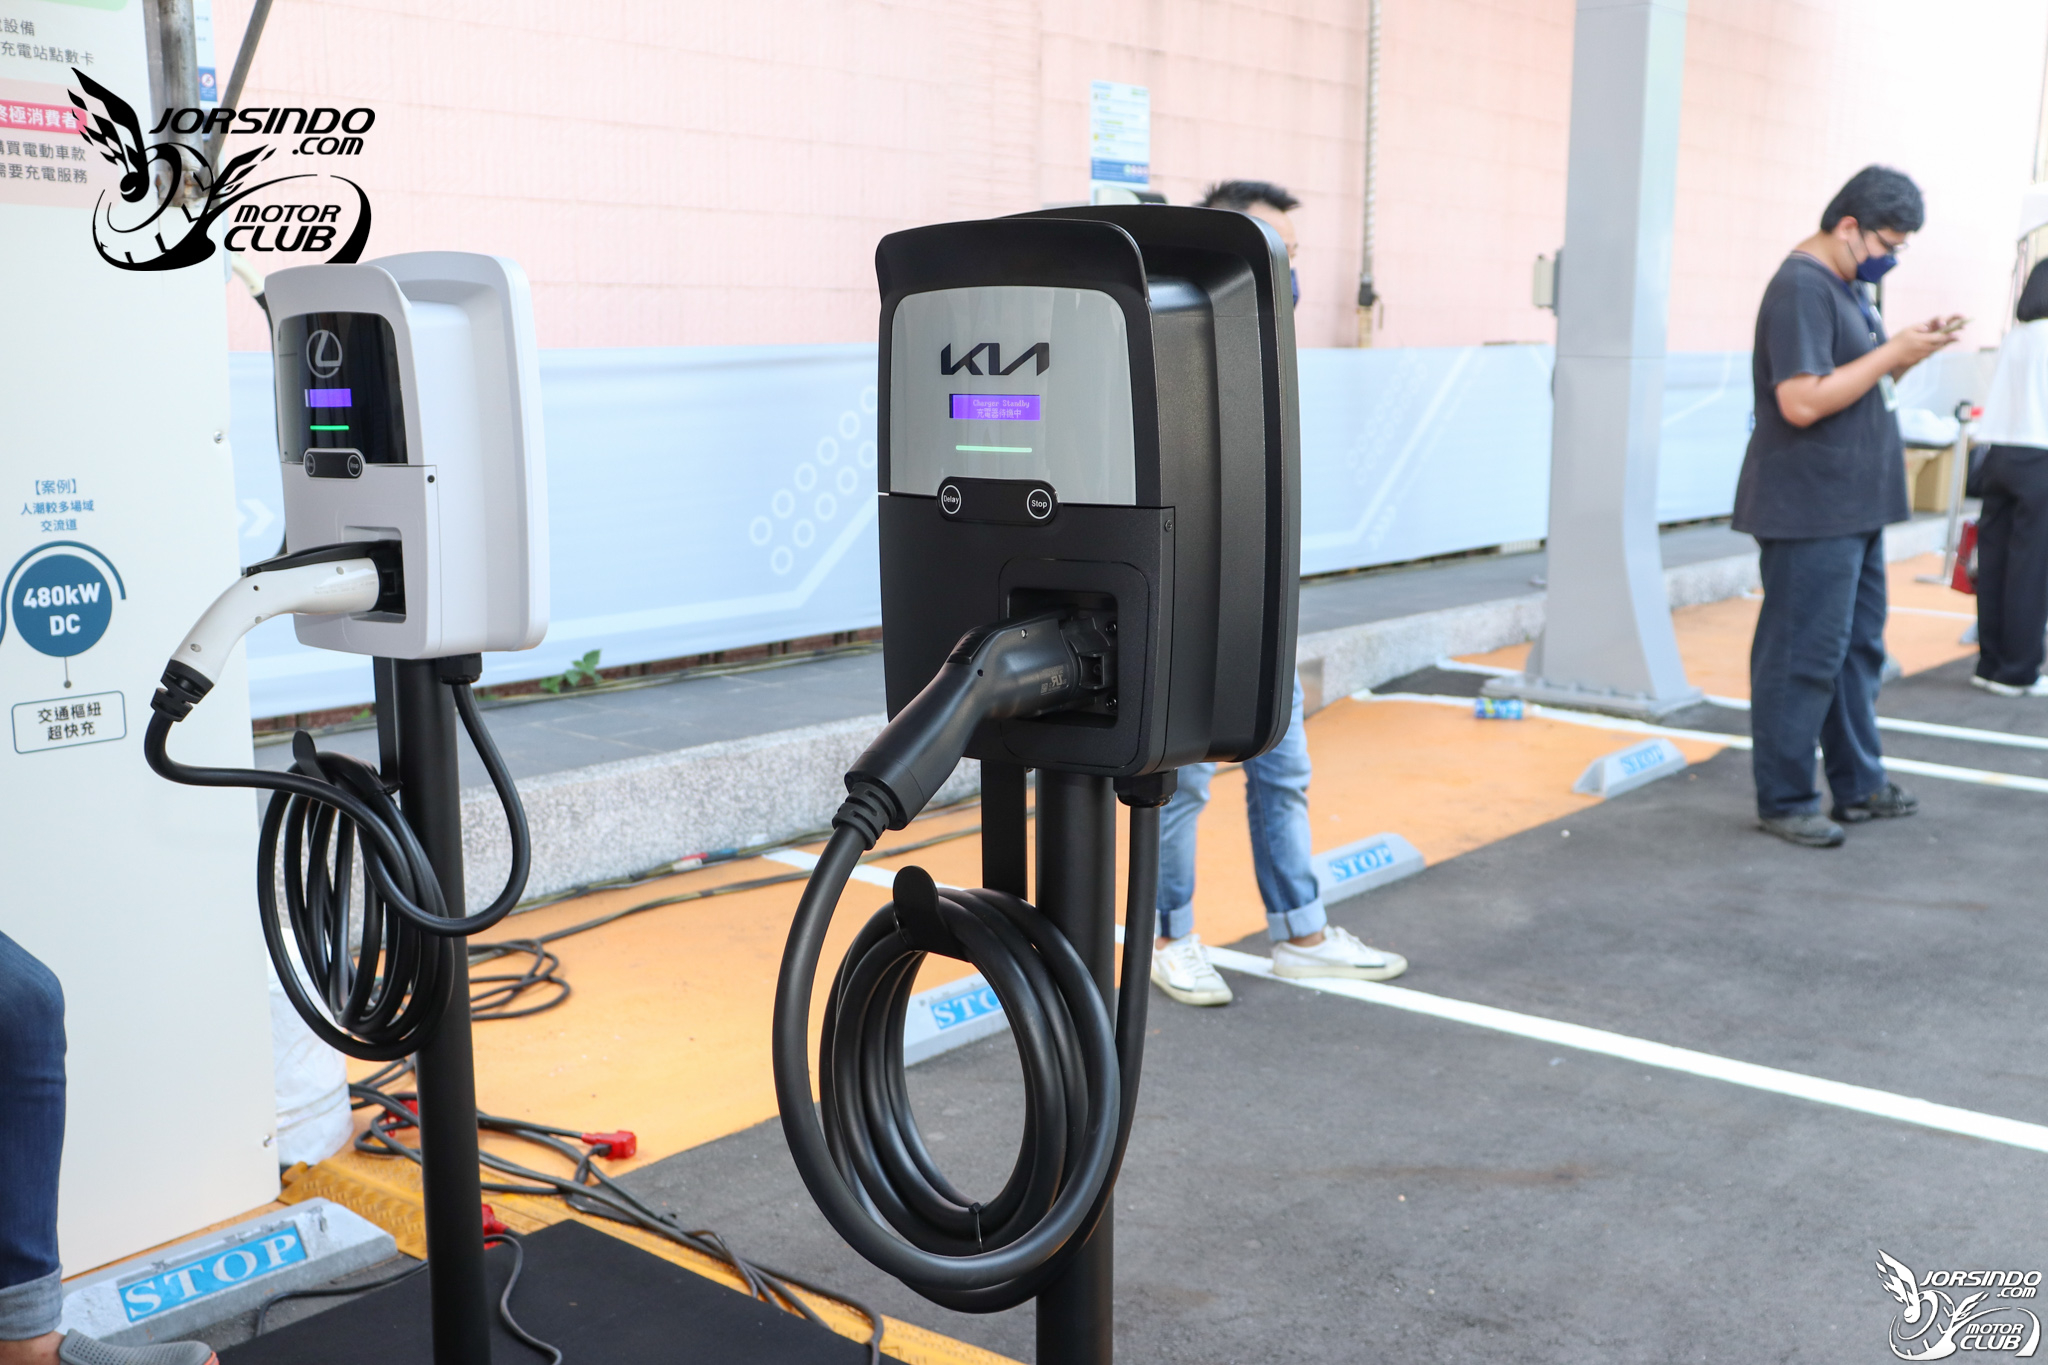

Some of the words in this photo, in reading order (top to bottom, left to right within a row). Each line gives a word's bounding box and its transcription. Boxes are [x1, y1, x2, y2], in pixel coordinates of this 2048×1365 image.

[0, 17, 35, 36] 設備
[972, 399, 1000, 408] Charger
[1002, 400, 1030, 409] Standby
[21, 499, 94, 515] 人潮較多場域
[1031, 499, 1048, 509] Stop
[40, 518, 77, 532] 交流道
[23, 582, 101, 608] 480kW
[50, 613, 81, 636] DC
[38, 702, 102, 724] 交通樞紐
[47, 721, 95, 741] 超快充
[1331, 847, 1390, 881] STOP
[934, 989, 1000, 1027] STO
[125, 1233, 297, 1319] STOP
